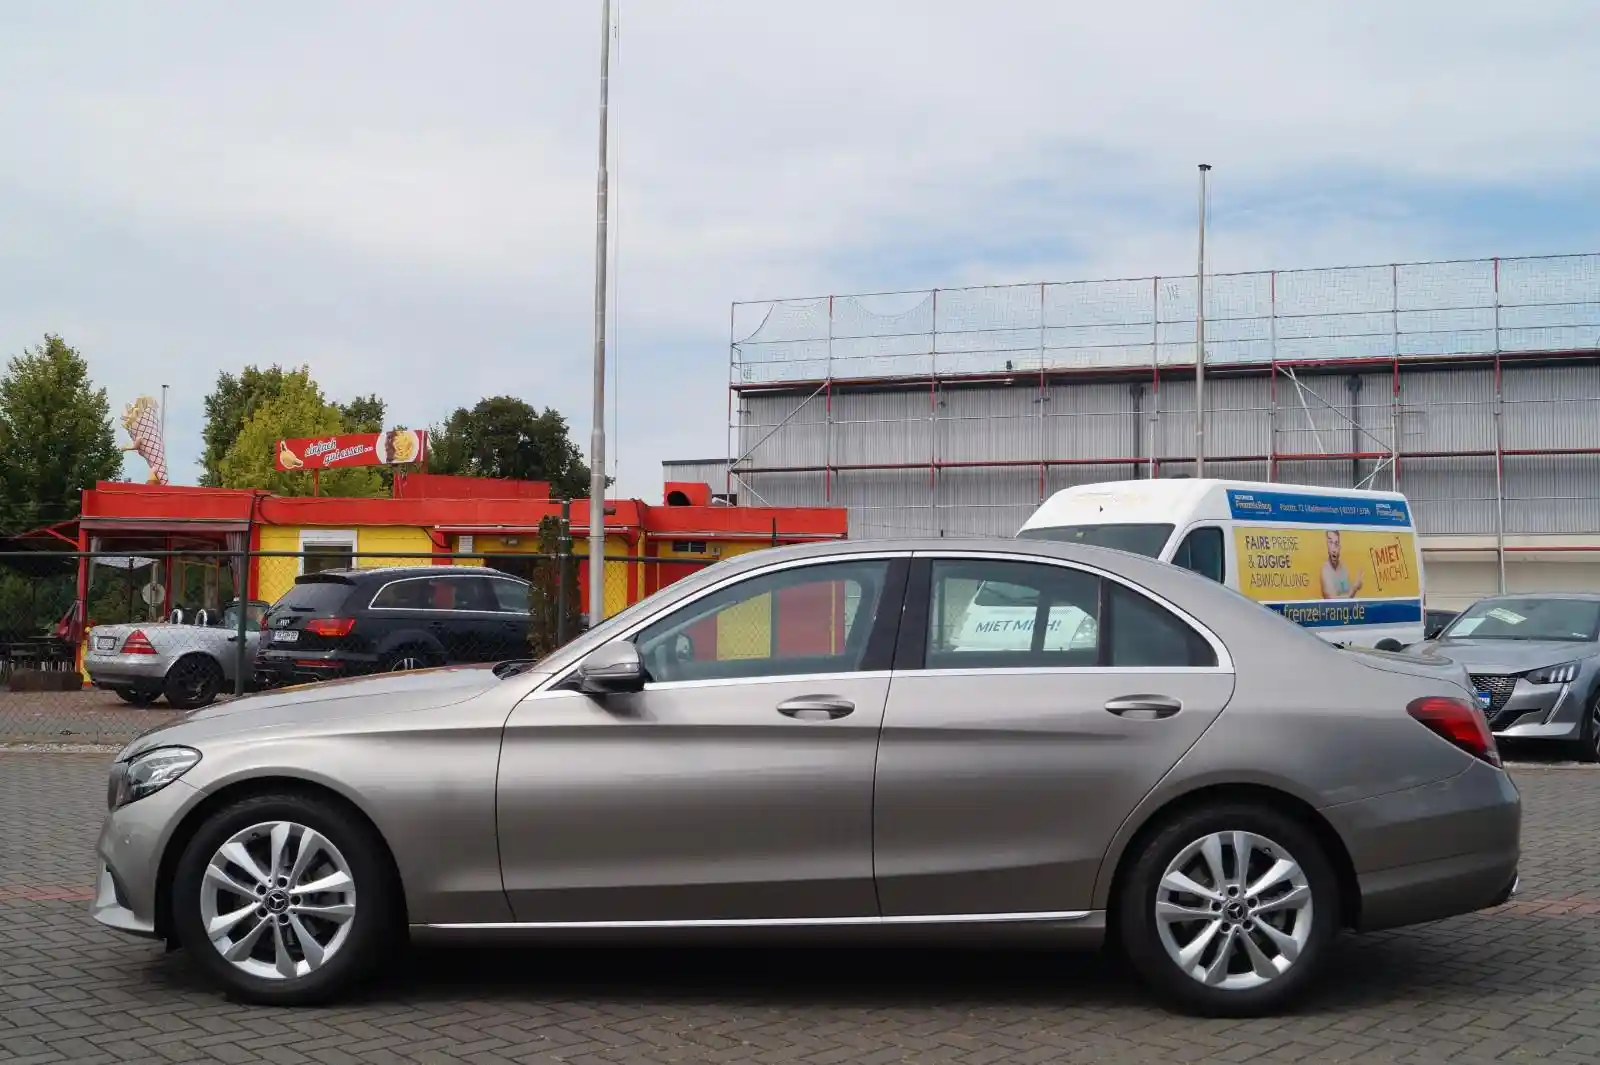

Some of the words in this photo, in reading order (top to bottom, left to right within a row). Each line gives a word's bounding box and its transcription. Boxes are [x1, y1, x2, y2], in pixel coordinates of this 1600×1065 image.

[1245, 535, 1271, 550] FAIRE
[1271, 536, 1300, 551] PREISE
[1374, 543, 1400, 567] MIET
[1250, 572, 1310, 589] ABWICKLUNG
[1274, 602, 1366, 625] frenzel-rang.de
[975, 620, 1013, 633] MIET
[1012, 618, 1062, 633] MIH!
